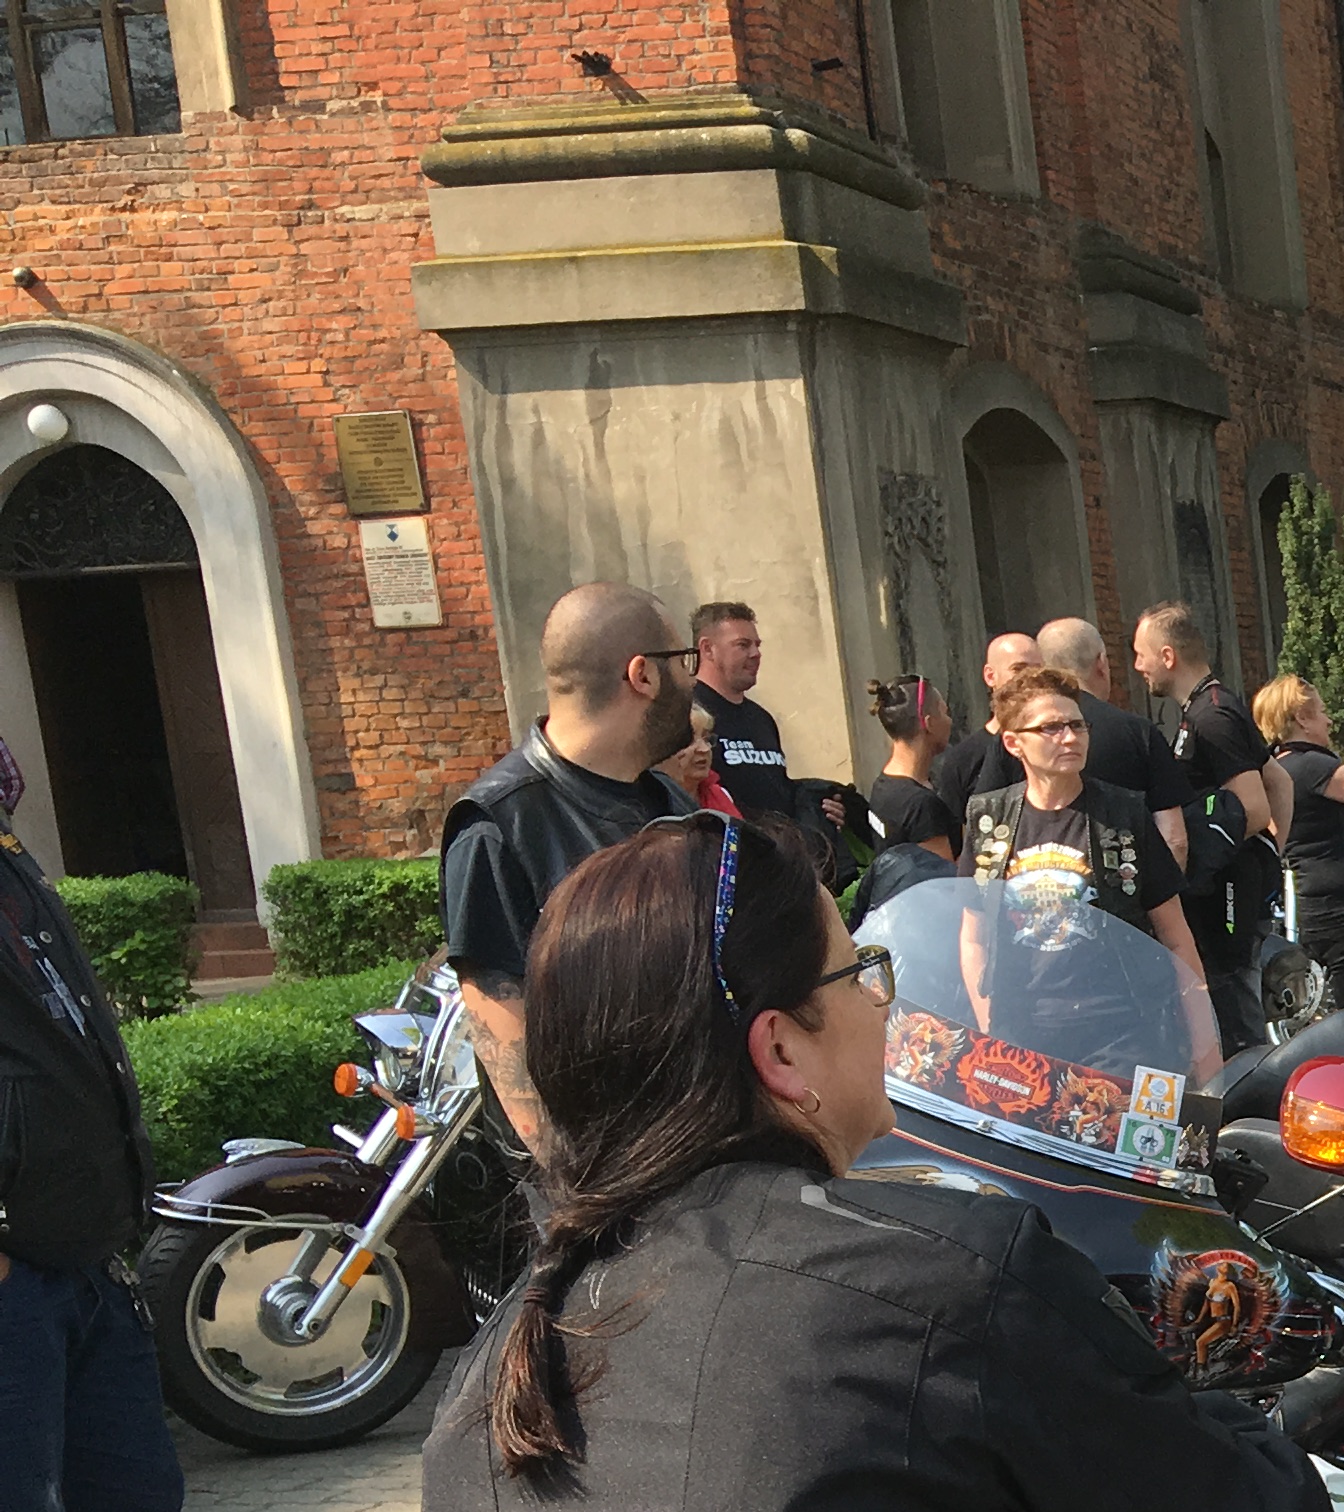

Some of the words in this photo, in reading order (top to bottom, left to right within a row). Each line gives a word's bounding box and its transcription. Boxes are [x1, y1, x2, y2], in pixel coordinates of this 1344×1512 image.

[719, 738, 754, 749] Team
[724, 750, 786, 767] SUZUK
[973, 1068, 1032, 1096] HARLEY-DAVIDSON
